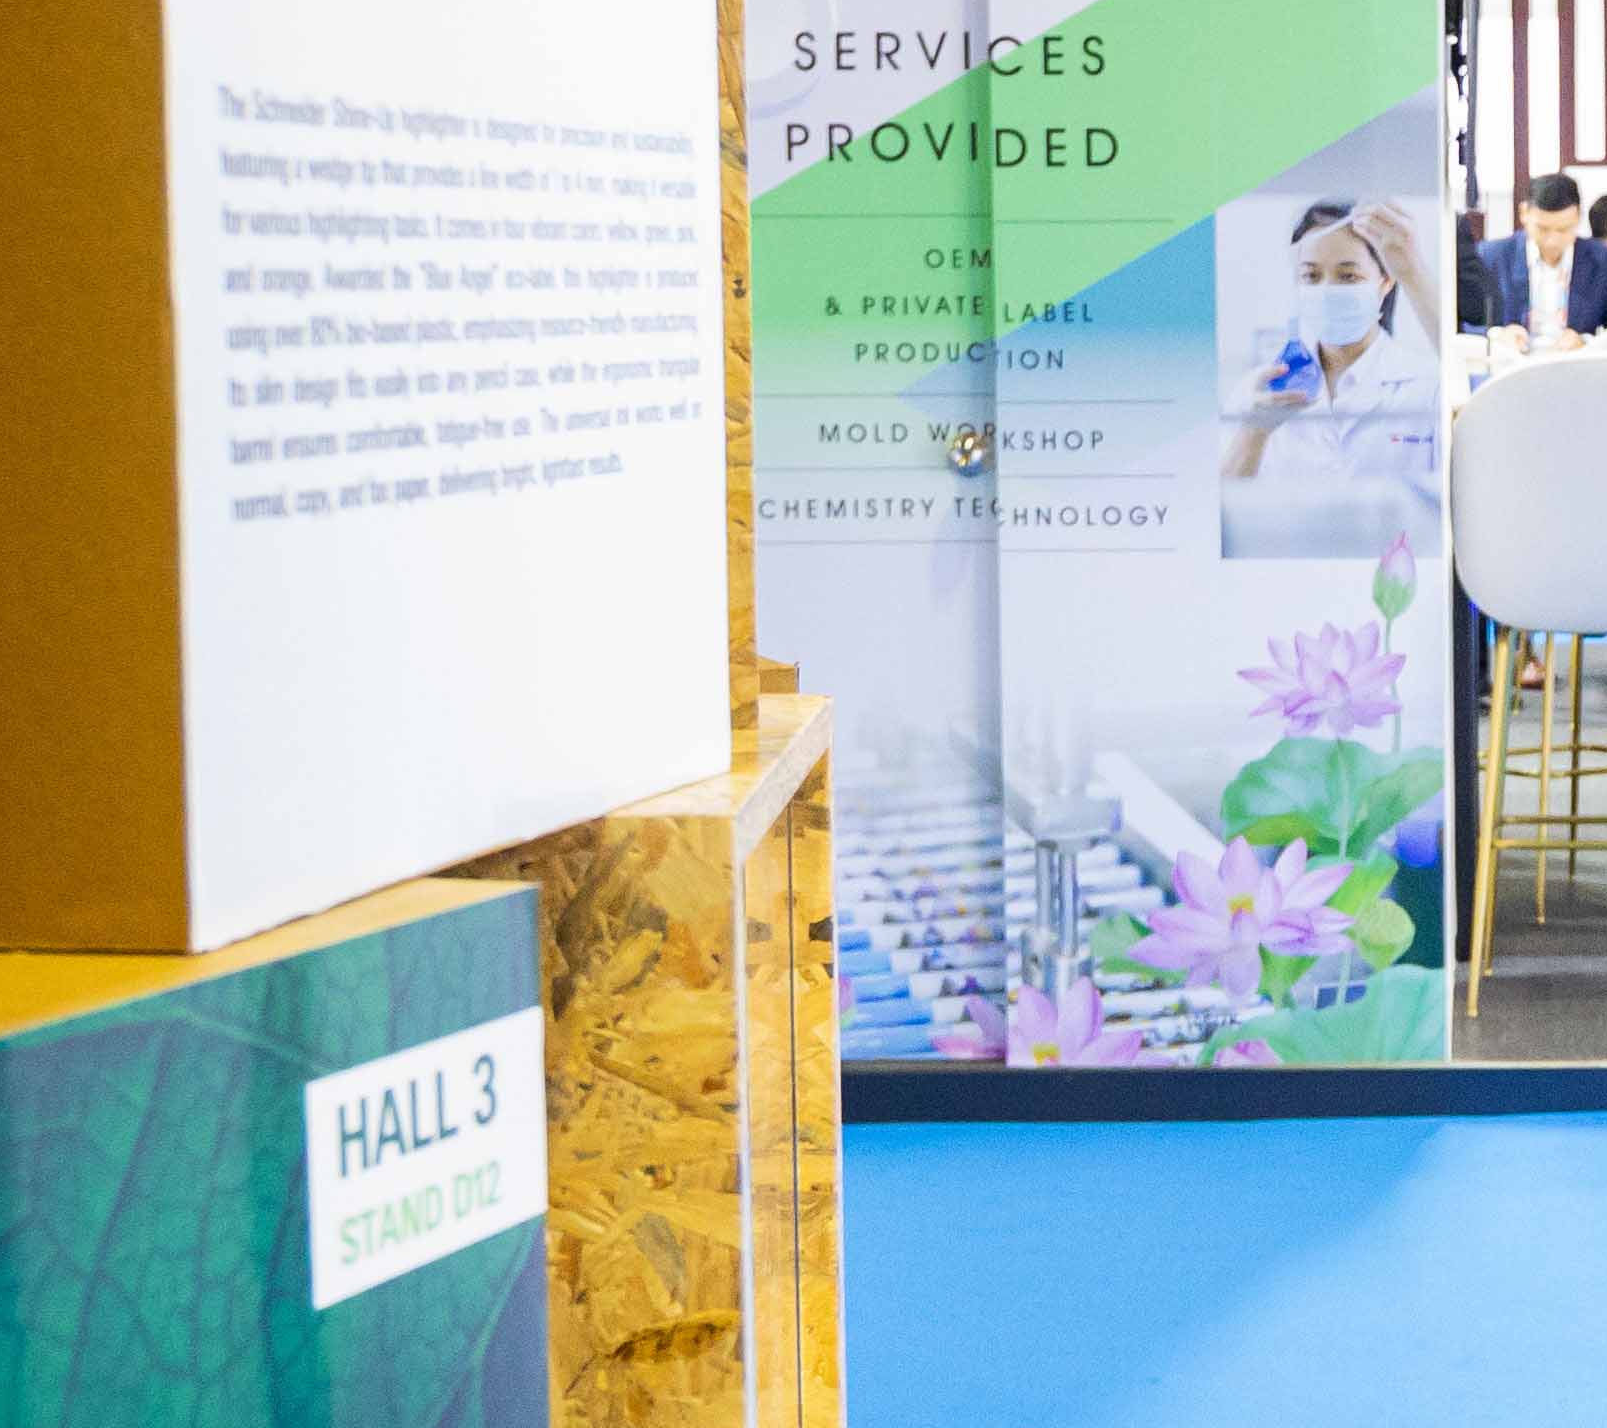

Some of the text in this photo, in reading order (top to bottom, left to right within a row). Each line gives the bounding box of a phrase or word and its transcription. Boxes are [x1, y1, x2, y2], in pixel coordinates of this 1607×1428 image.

[794, 31, 1107, 78] SERVICES
[787, 122, 1121, 168] PROVIDED
[924, 248, 993, 270] OEM
[825, 296, 1094, 323] & PRIVATE LABEL
[819, 423, 909, 444] MOLD
[759, 496, 935, 520] CHEMISTRY
[338, 1053, 497, 1178] HALL 3
[340, 1160, 502, 1266] STAND D12
